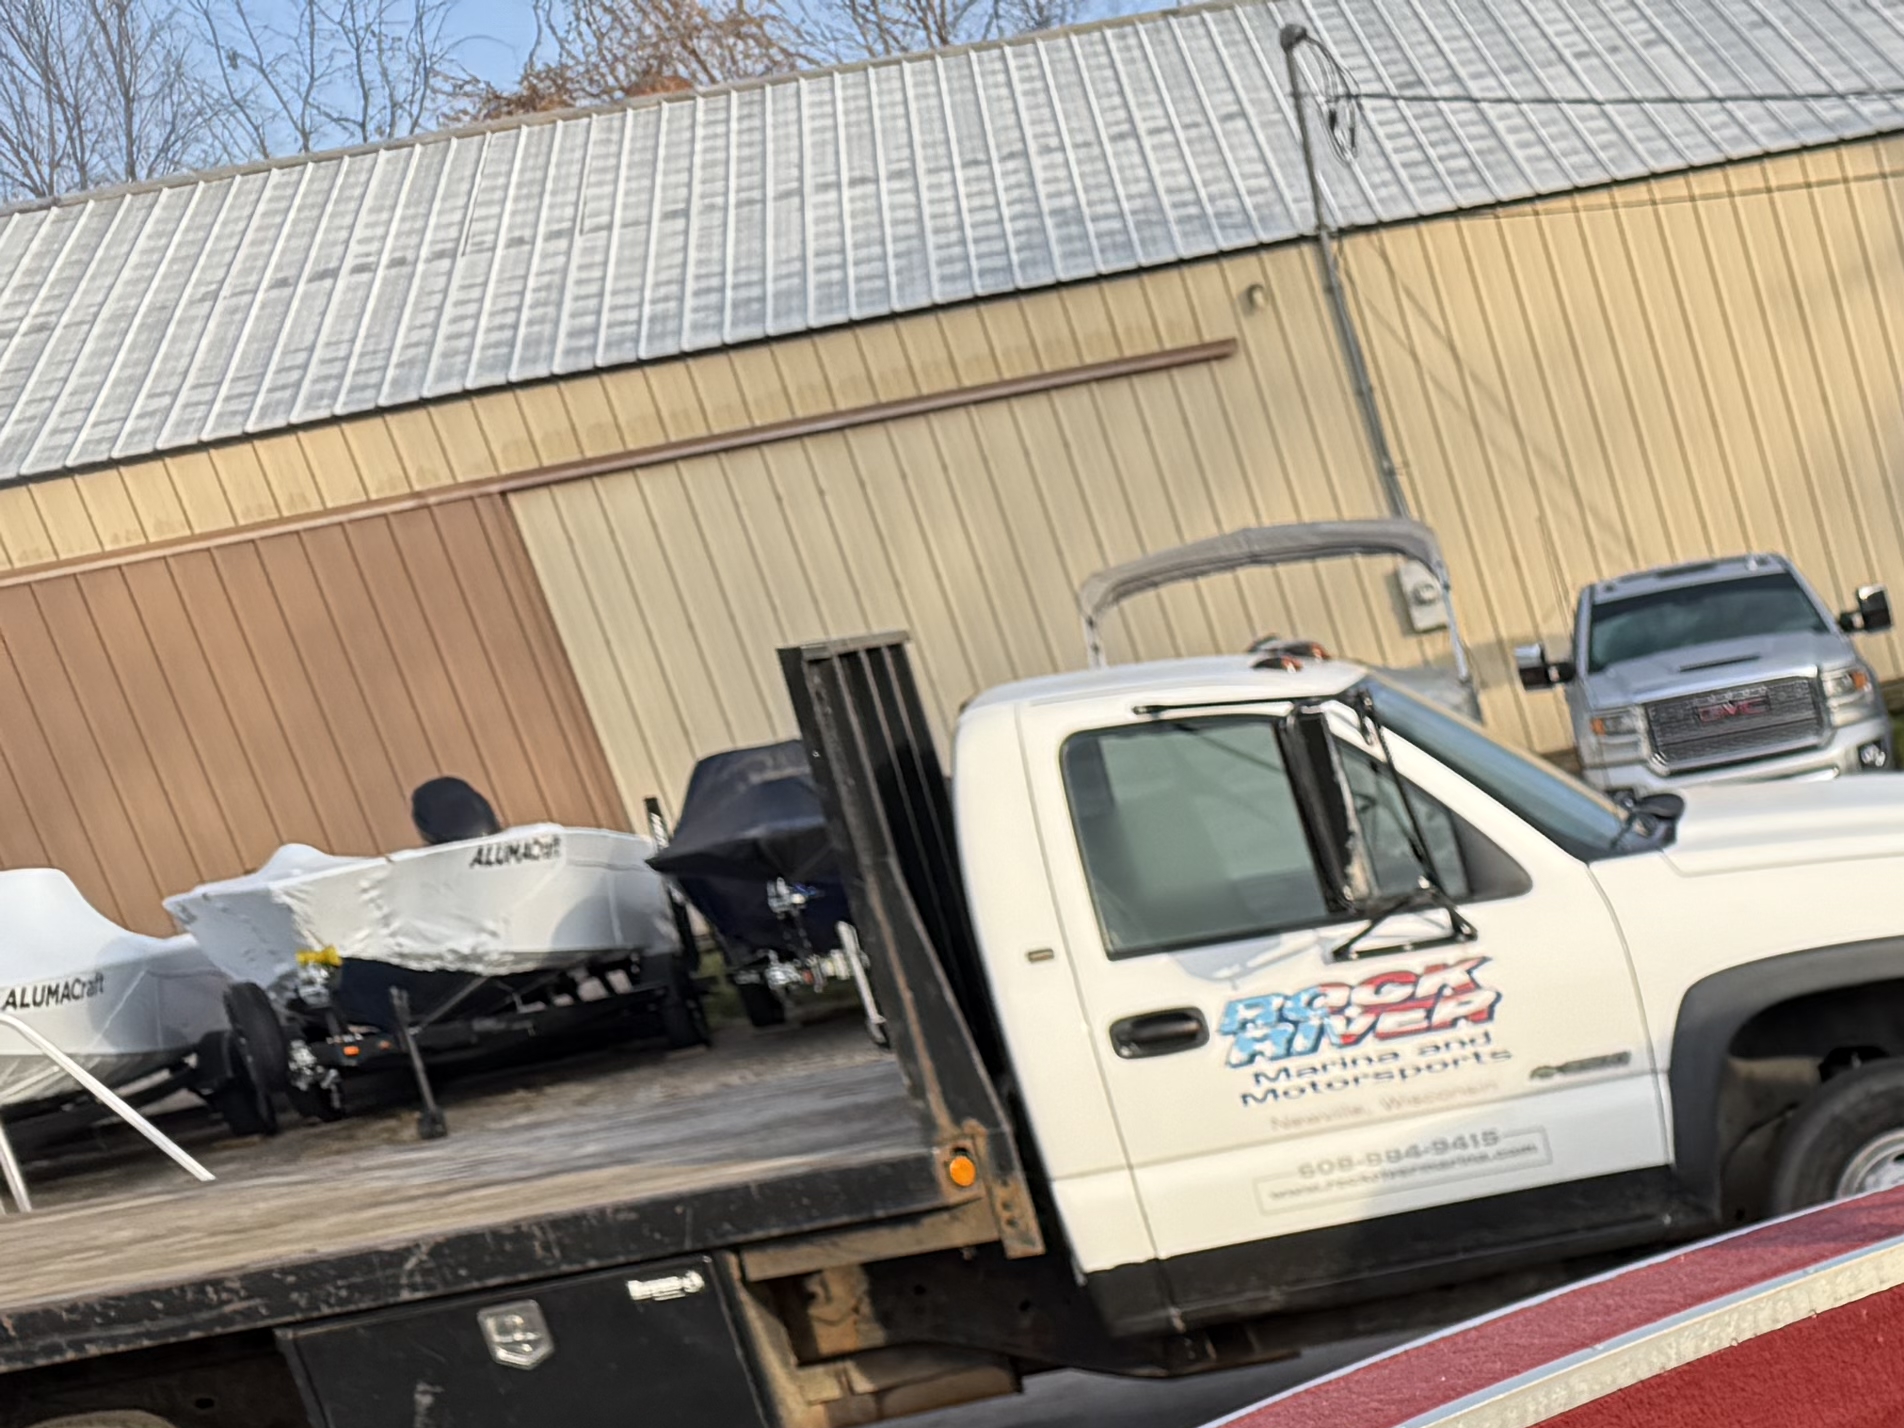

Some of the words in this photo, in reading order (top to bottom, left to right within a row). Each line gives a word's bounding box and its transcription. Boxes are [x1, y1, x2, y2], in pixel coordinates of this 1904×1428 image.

[1697, 697, 1770, 723] GMC
[1218, 956, 1493, 1036] ROCK
[1225, 988, 1503, 1068] RIVER
[1241, 1049, 1513, 1108] Motorsports
[1253, 1050, 1400, 1086] Marina
[1419, 1030, 1493, 1058] and
